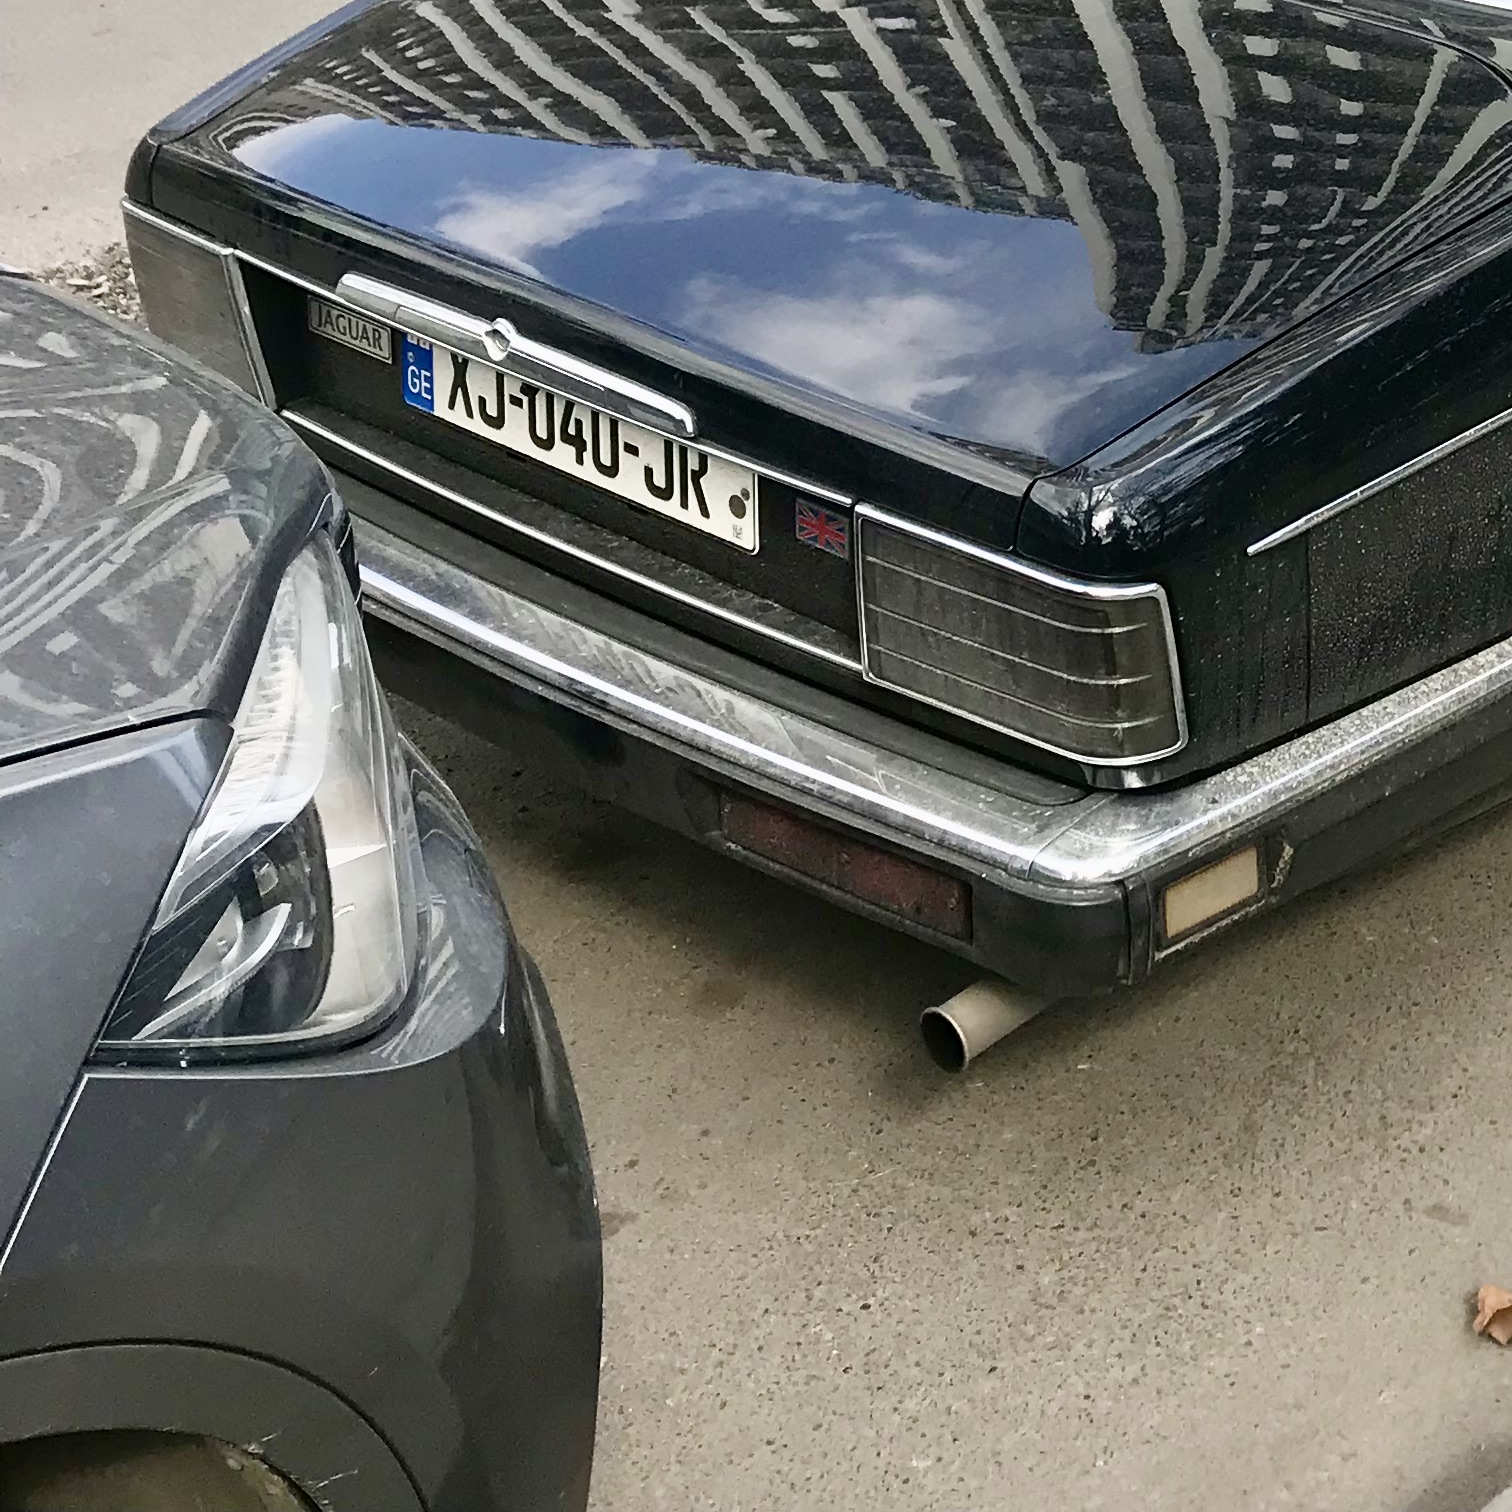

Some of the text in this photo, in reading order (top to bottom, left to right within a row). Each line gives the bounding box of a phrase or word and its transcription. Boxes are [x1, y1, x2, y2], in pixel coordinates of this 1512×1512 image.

[317, 303, 383, 352] JAGUAR
[407, 352, 711, 520] GE XJ-040-JR
